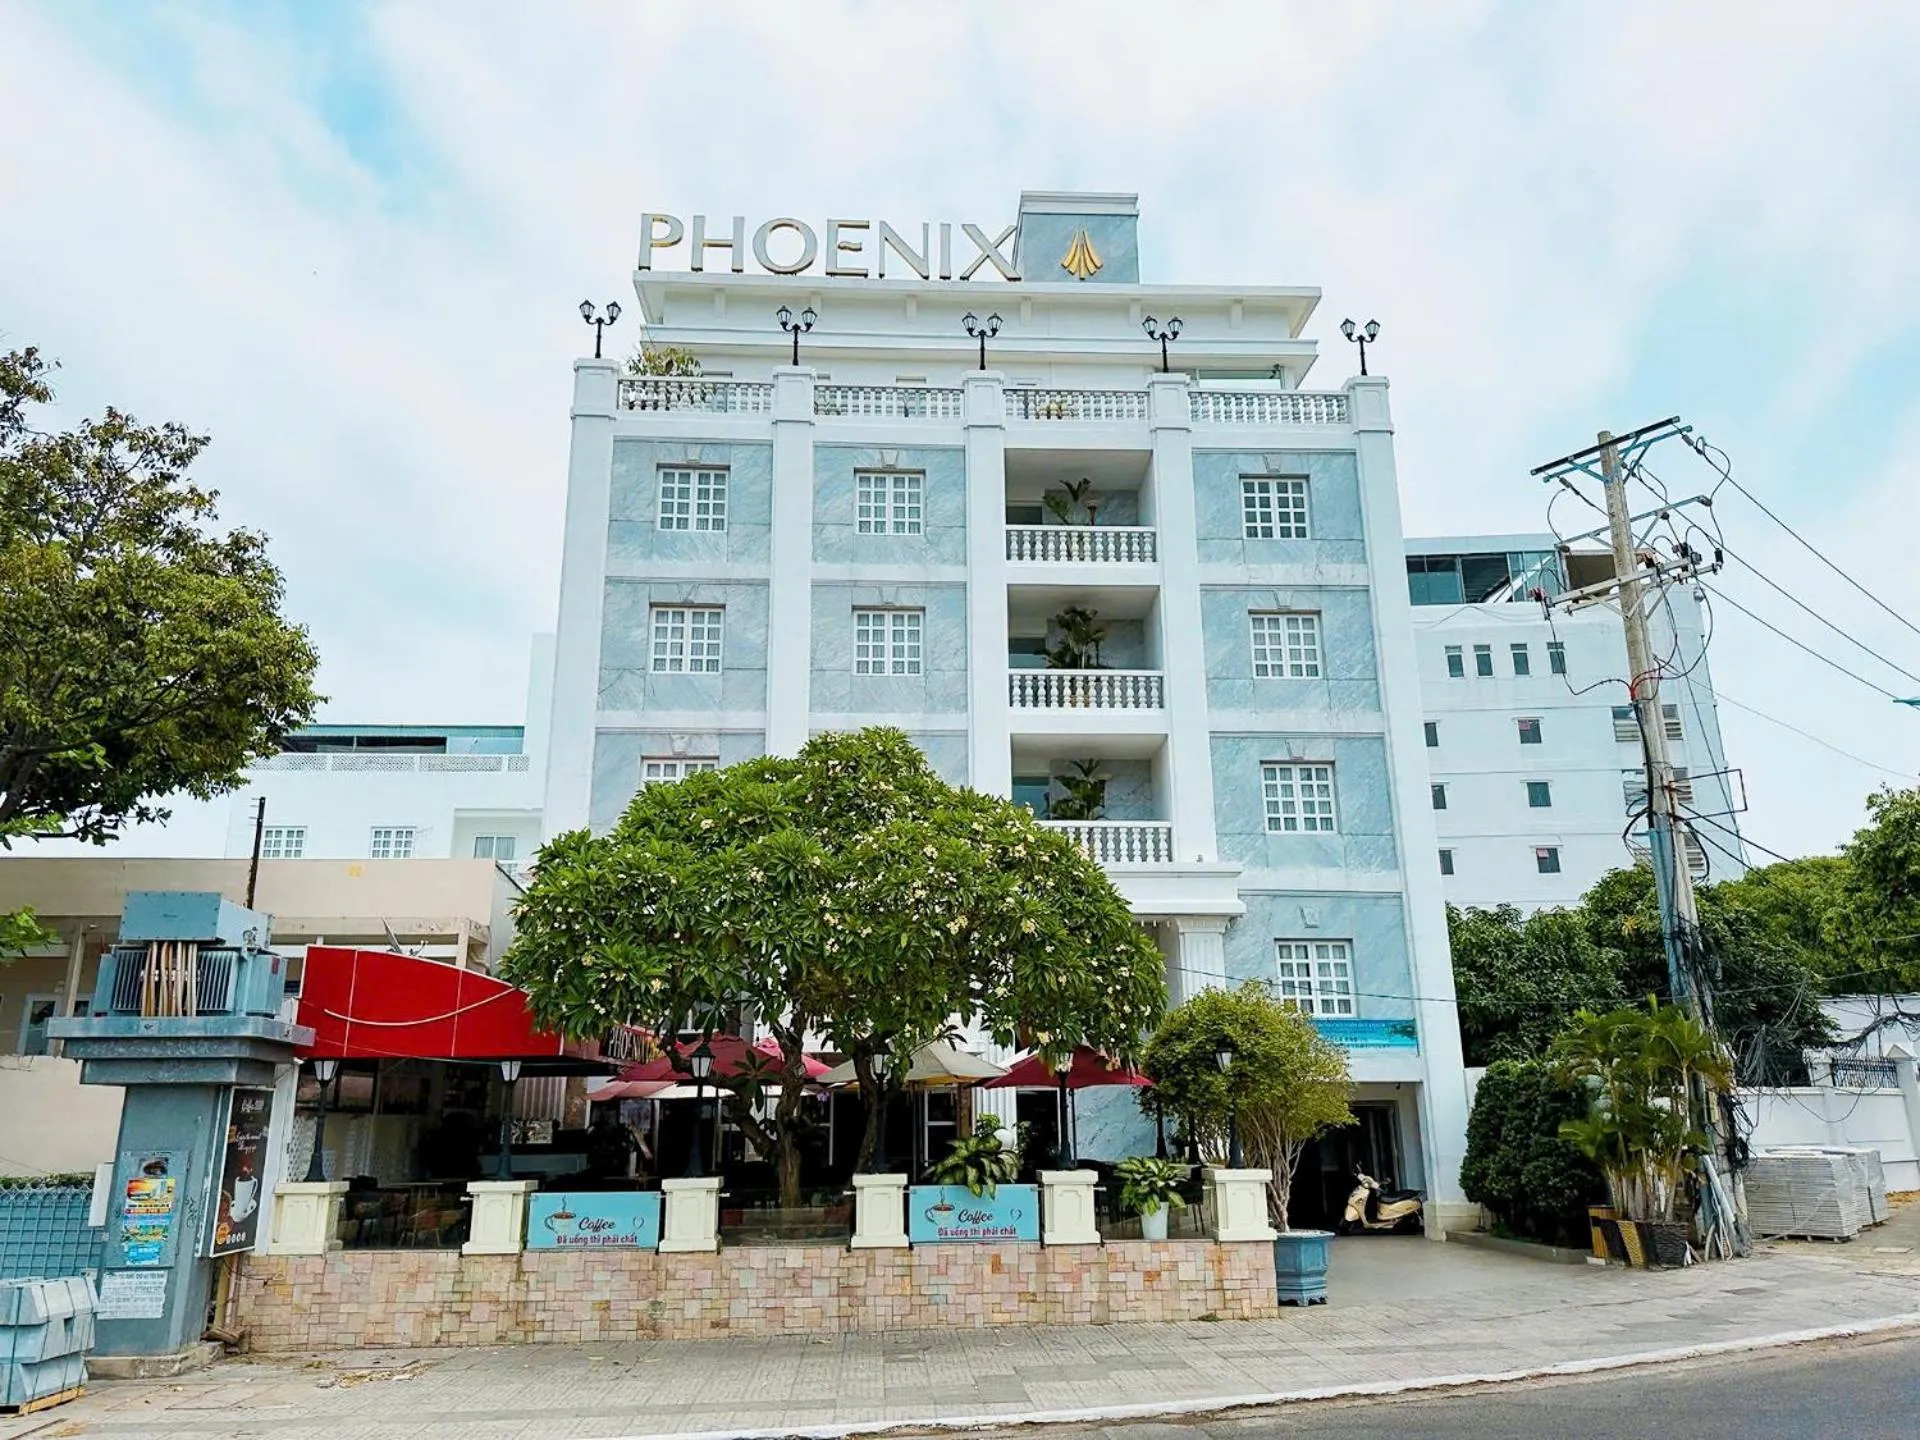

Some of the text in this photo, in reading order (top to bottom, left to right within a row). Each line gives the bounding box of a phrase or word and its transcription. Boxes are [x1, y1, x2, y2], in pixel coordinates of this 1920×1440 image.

[638, 213, 1022, 282] PHOENIX
[578, 1216, 616, 1232] Coffee
[958, 1208, 994, 1224] Coffee
